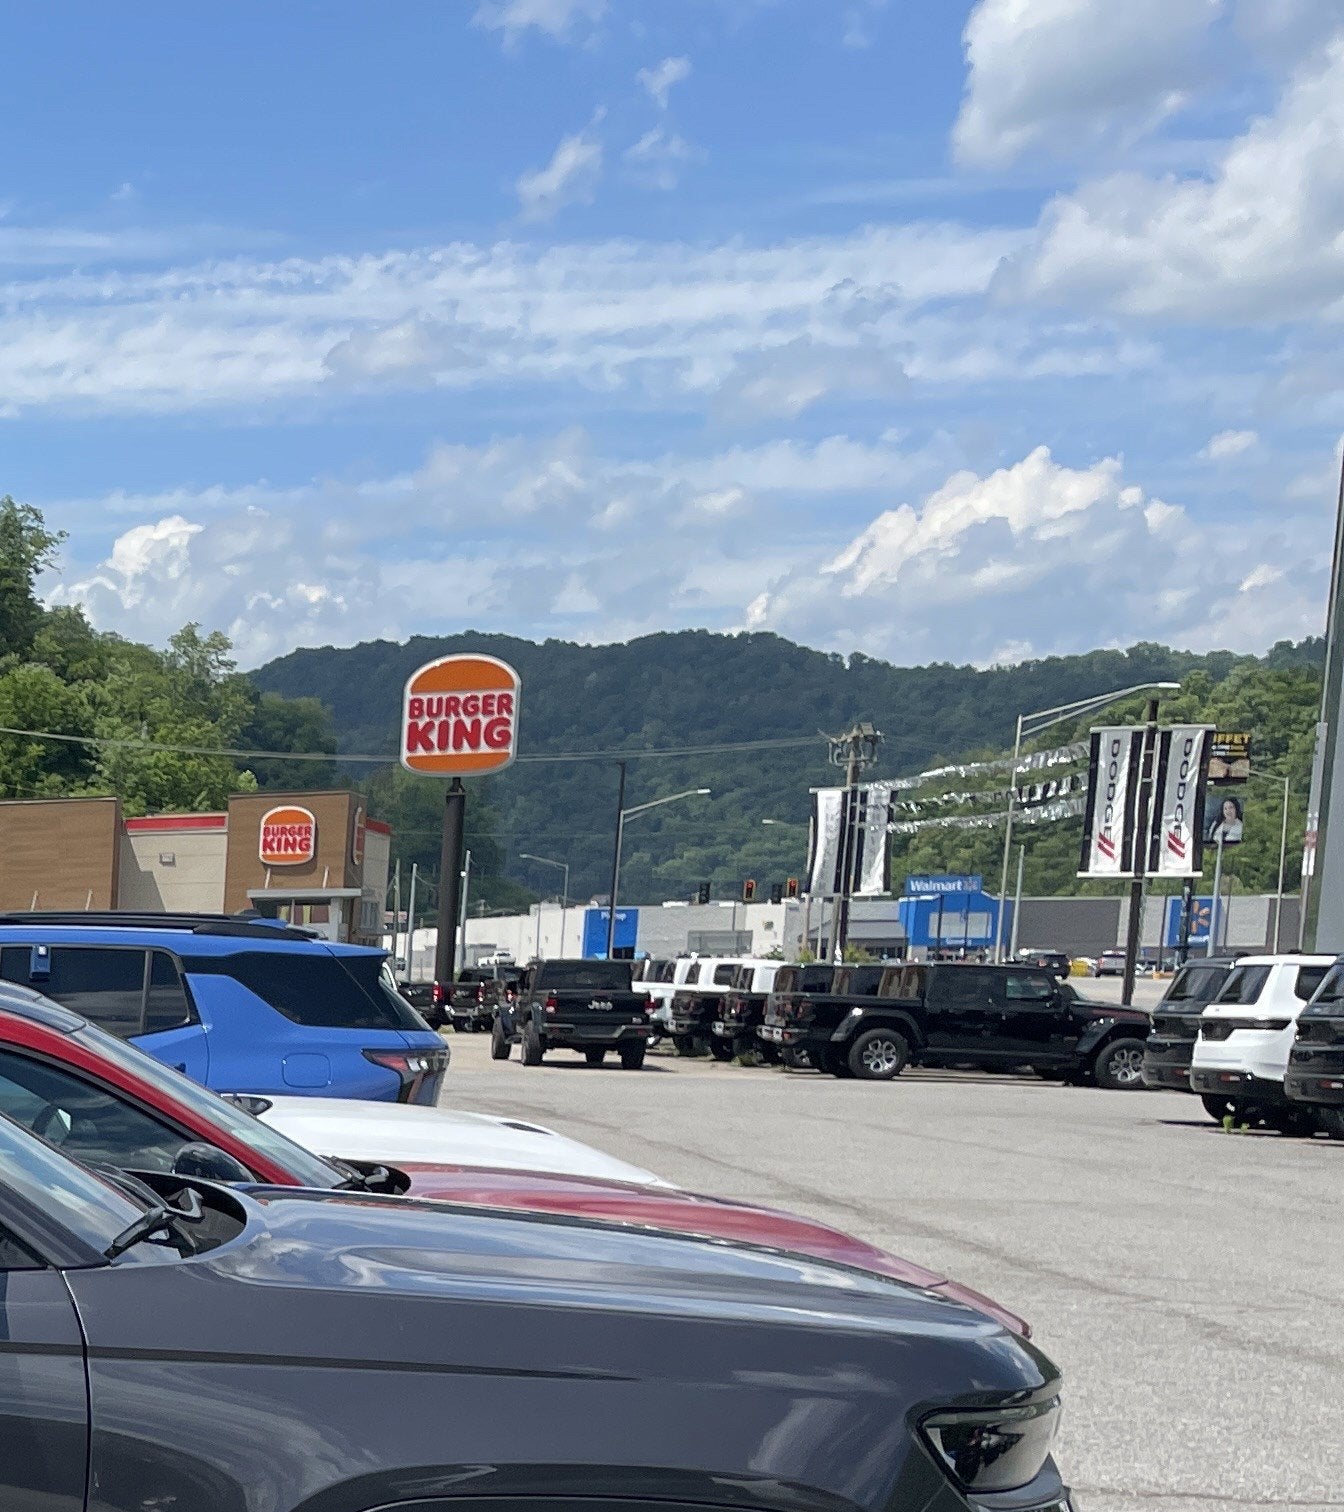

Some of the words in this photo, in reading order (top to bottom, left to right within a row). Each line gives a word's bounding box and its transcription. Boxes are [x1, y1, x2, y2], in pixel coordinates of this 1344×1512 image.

[408, 692, 513, 720] BURGER
[405, 716, 512, 754] KING
[1104, 739, 1120, 842] DODGE
[1174, 738, 1193, 841] DODGE
[262, 836, 311, 852] KING
[263, 825, 312, 838] BURGER
[910, 880, 963, 892] Walmart
